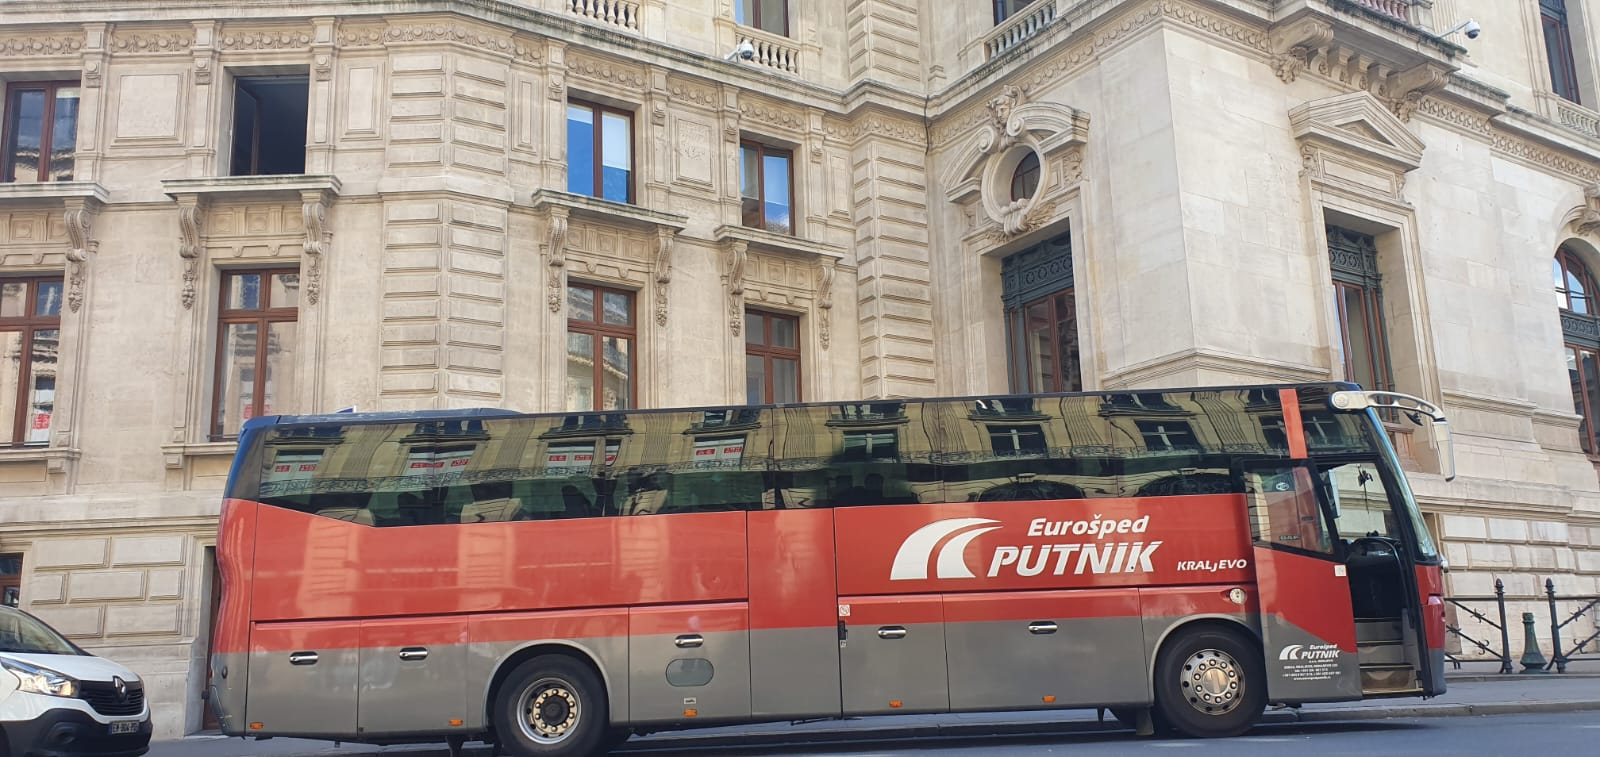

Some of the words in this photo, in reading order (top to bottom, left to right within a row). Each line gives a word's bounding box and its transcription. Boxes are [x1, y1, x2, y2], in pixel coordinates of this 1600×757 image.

[1027, 514, 1150, 539] Eurošped
[987, 541, 1163, 577] PUTNIK
[1301, 650, 1340, 659] PUTNIK
